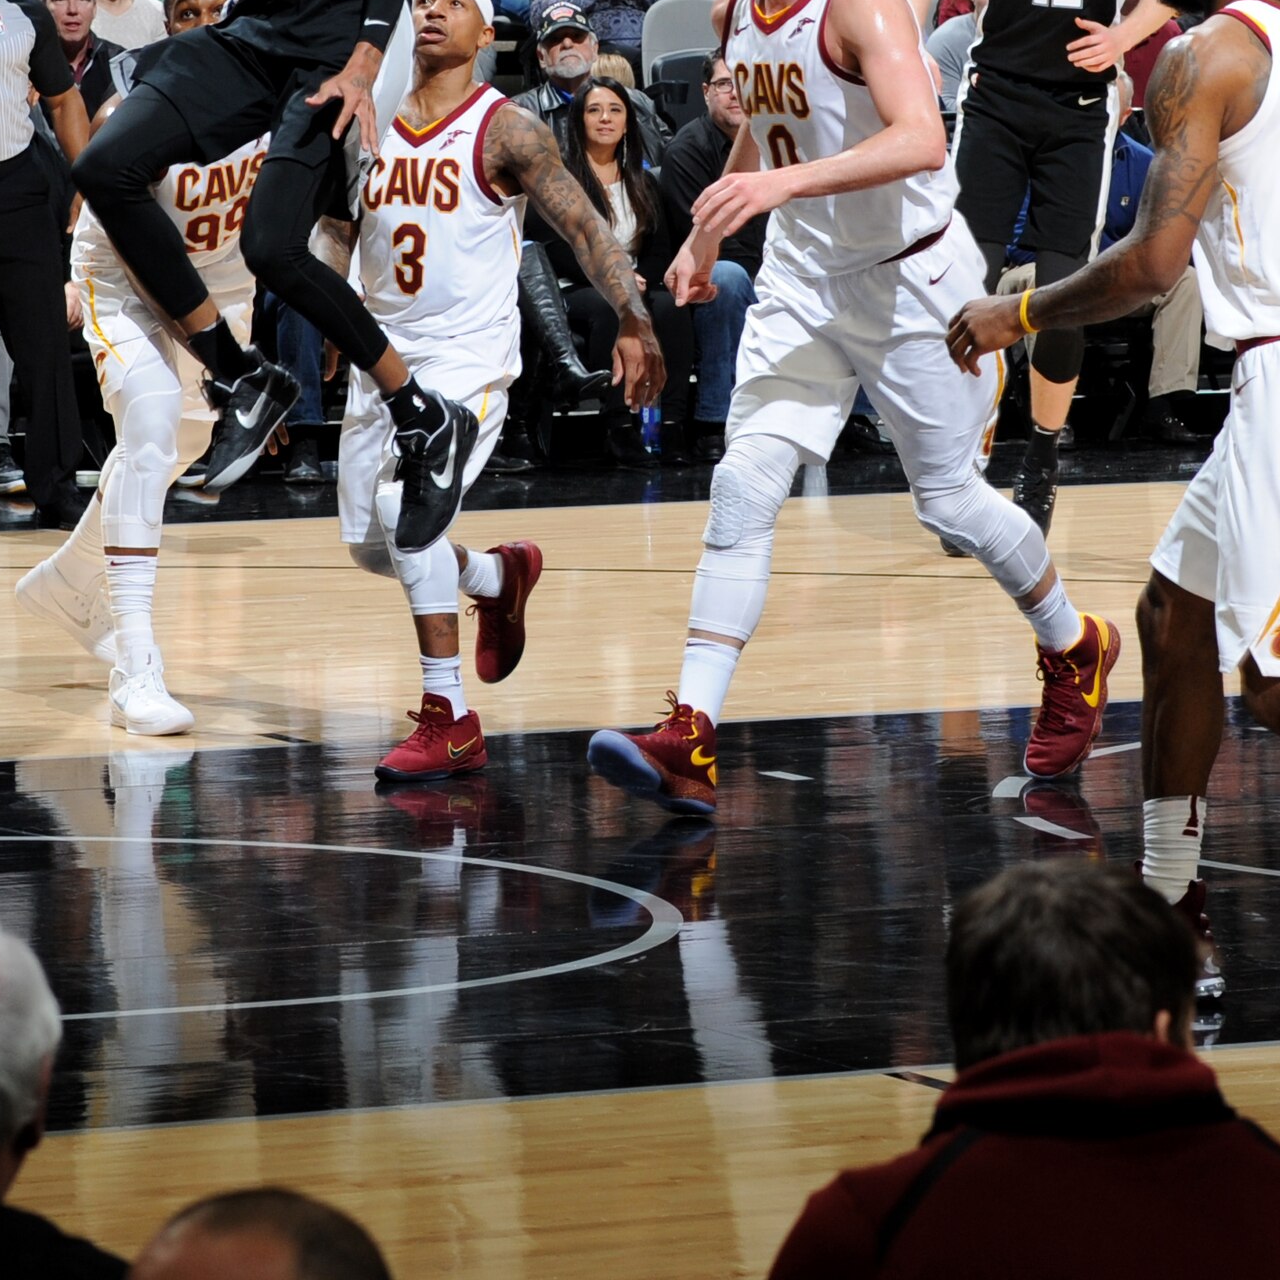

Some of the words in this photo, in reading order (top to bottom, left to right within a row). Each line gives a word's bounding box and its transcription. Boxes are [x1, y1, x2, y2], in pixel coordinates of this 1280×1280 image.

[733, 61, 810, 120] CAVS
[176, 151, 266, 212] CAVS
[363, 156, 462, 213] CAVS
[184, 194, 249, 252] 99
[392, 221, 427, 296] 3
